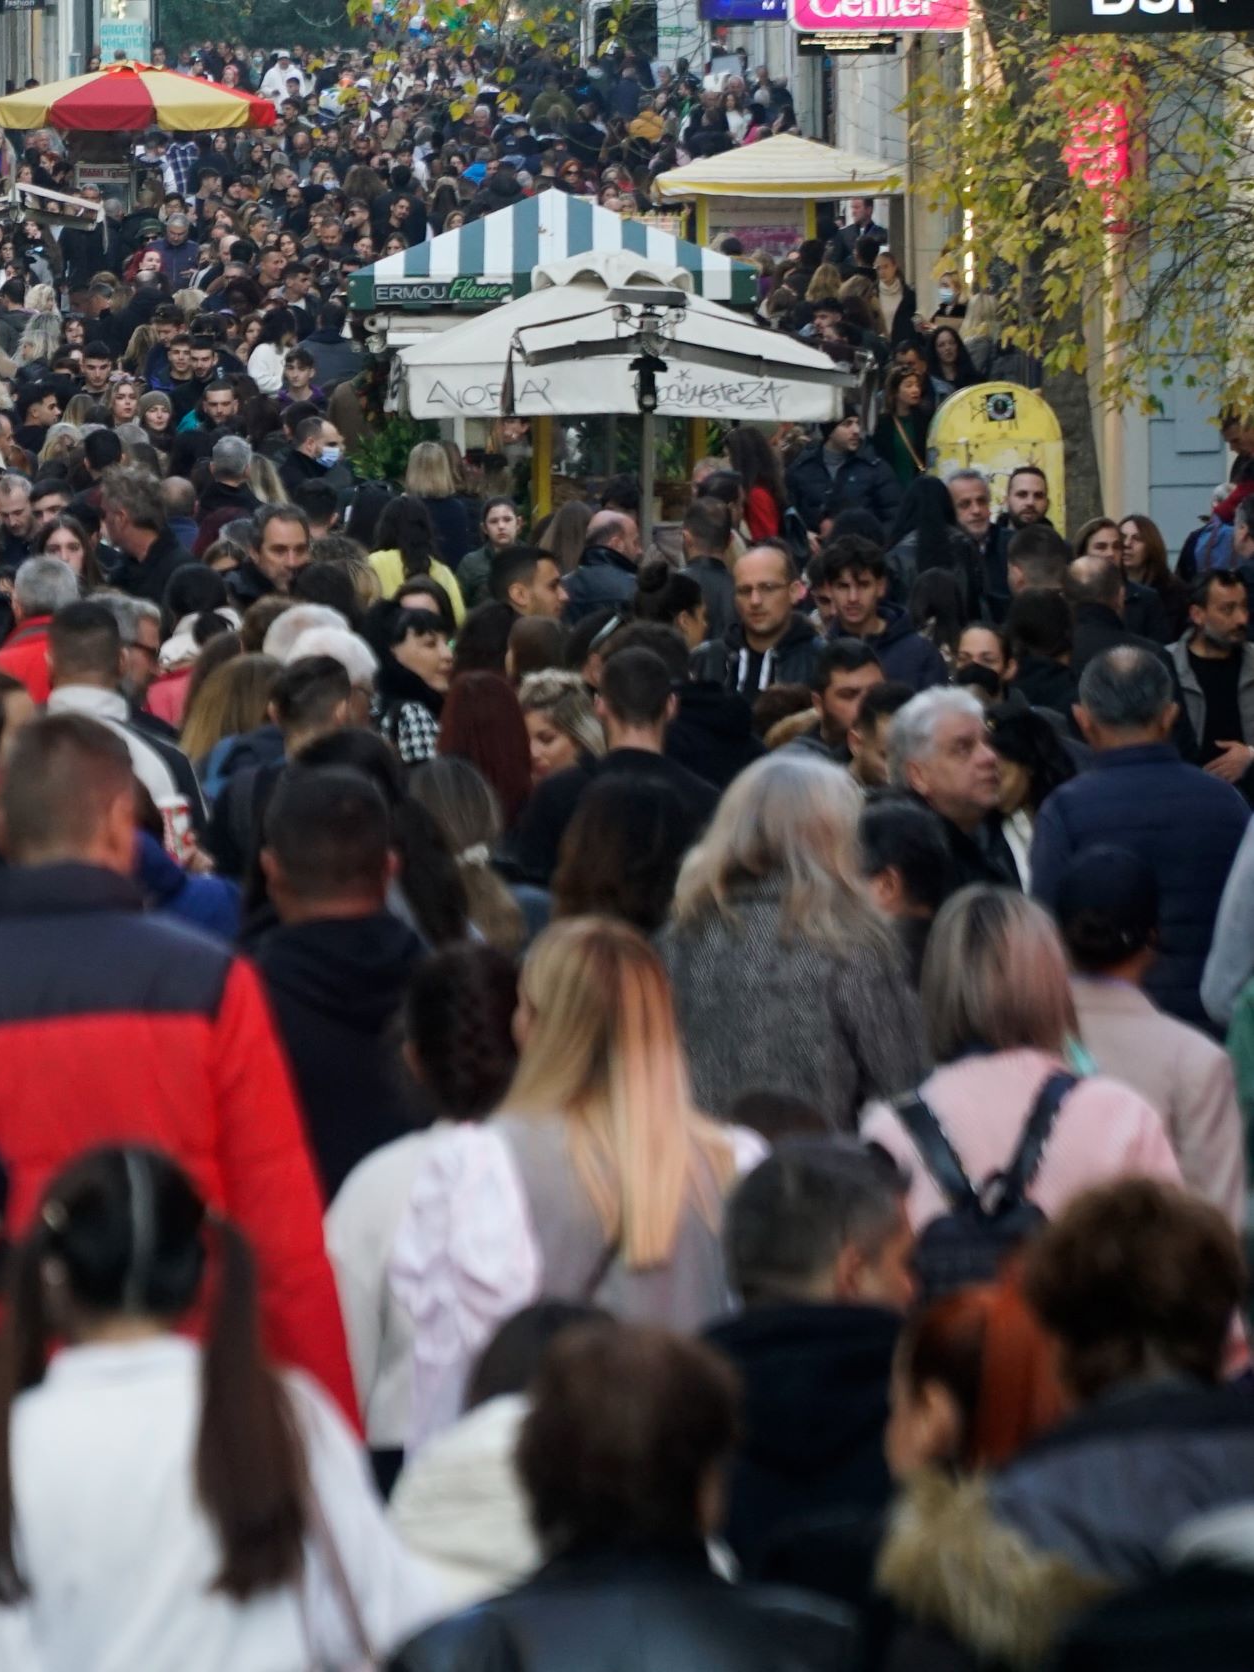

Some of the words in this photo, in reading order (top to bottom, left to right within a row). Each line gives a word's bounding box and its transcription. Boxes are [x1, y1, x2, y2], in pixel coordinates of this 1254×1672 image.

[809, 0, 937, 17] Center
[376, 286, 445, 299] ERMOU
[449, 278, 510, 299] Flower
